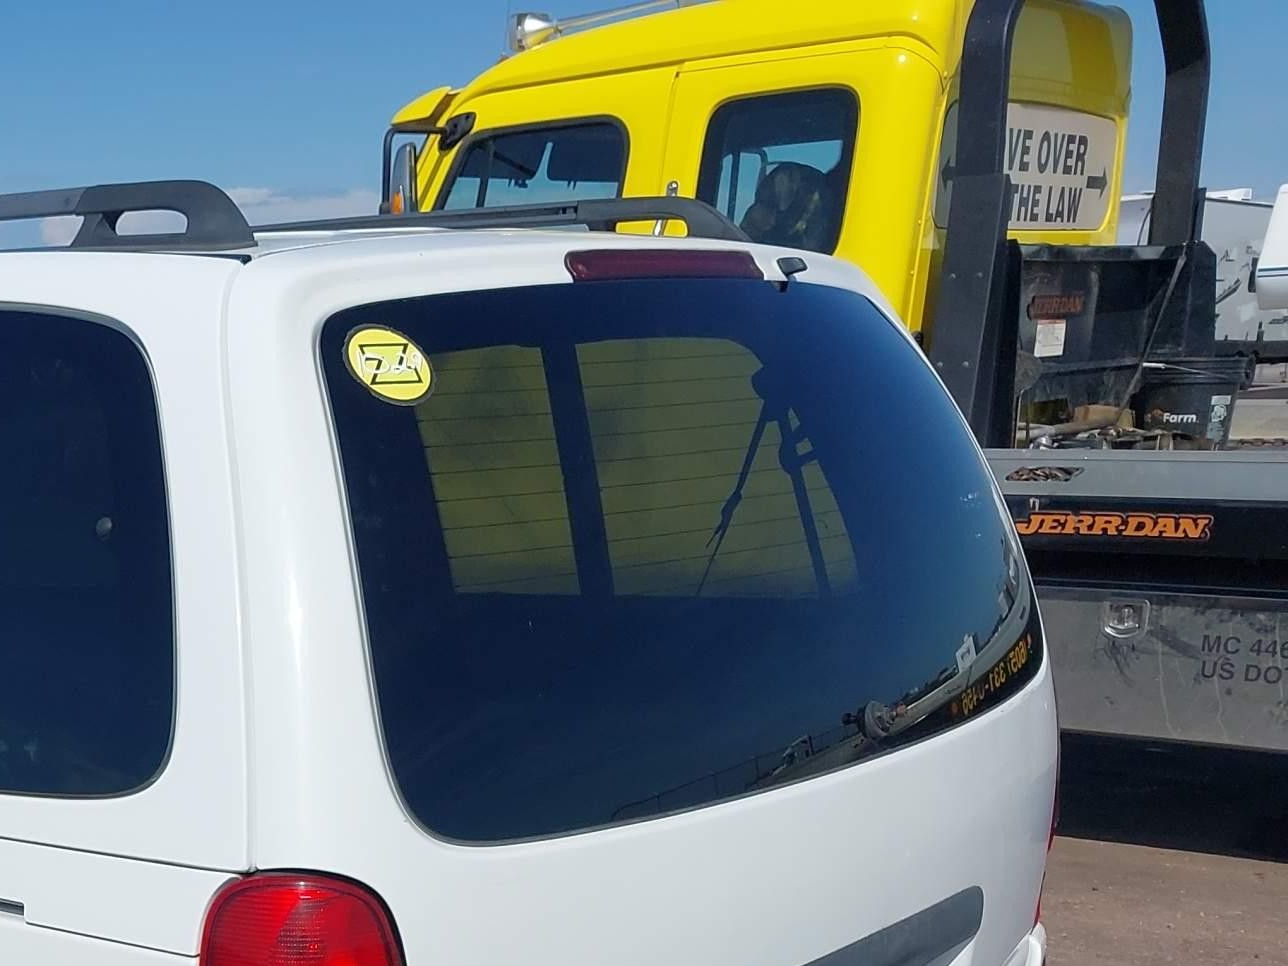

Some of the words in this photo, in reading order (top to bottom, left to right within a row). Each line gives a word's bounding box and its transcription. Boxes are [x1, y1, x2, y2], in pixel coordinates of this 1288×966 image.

[1007, 128, 1034, 172] VE
[1037, 131, 1089, 176] OVER
[1045, 186, 1082, 223] LAW
[1163, 412, 1197, 423] Farm
[1016, 514, 1212, 540] JERR-DAN
[1201, 634, 1241, 655] MC
[1200, 660, 1235, 680] US
[1244, 664, 1288, 684] DO
